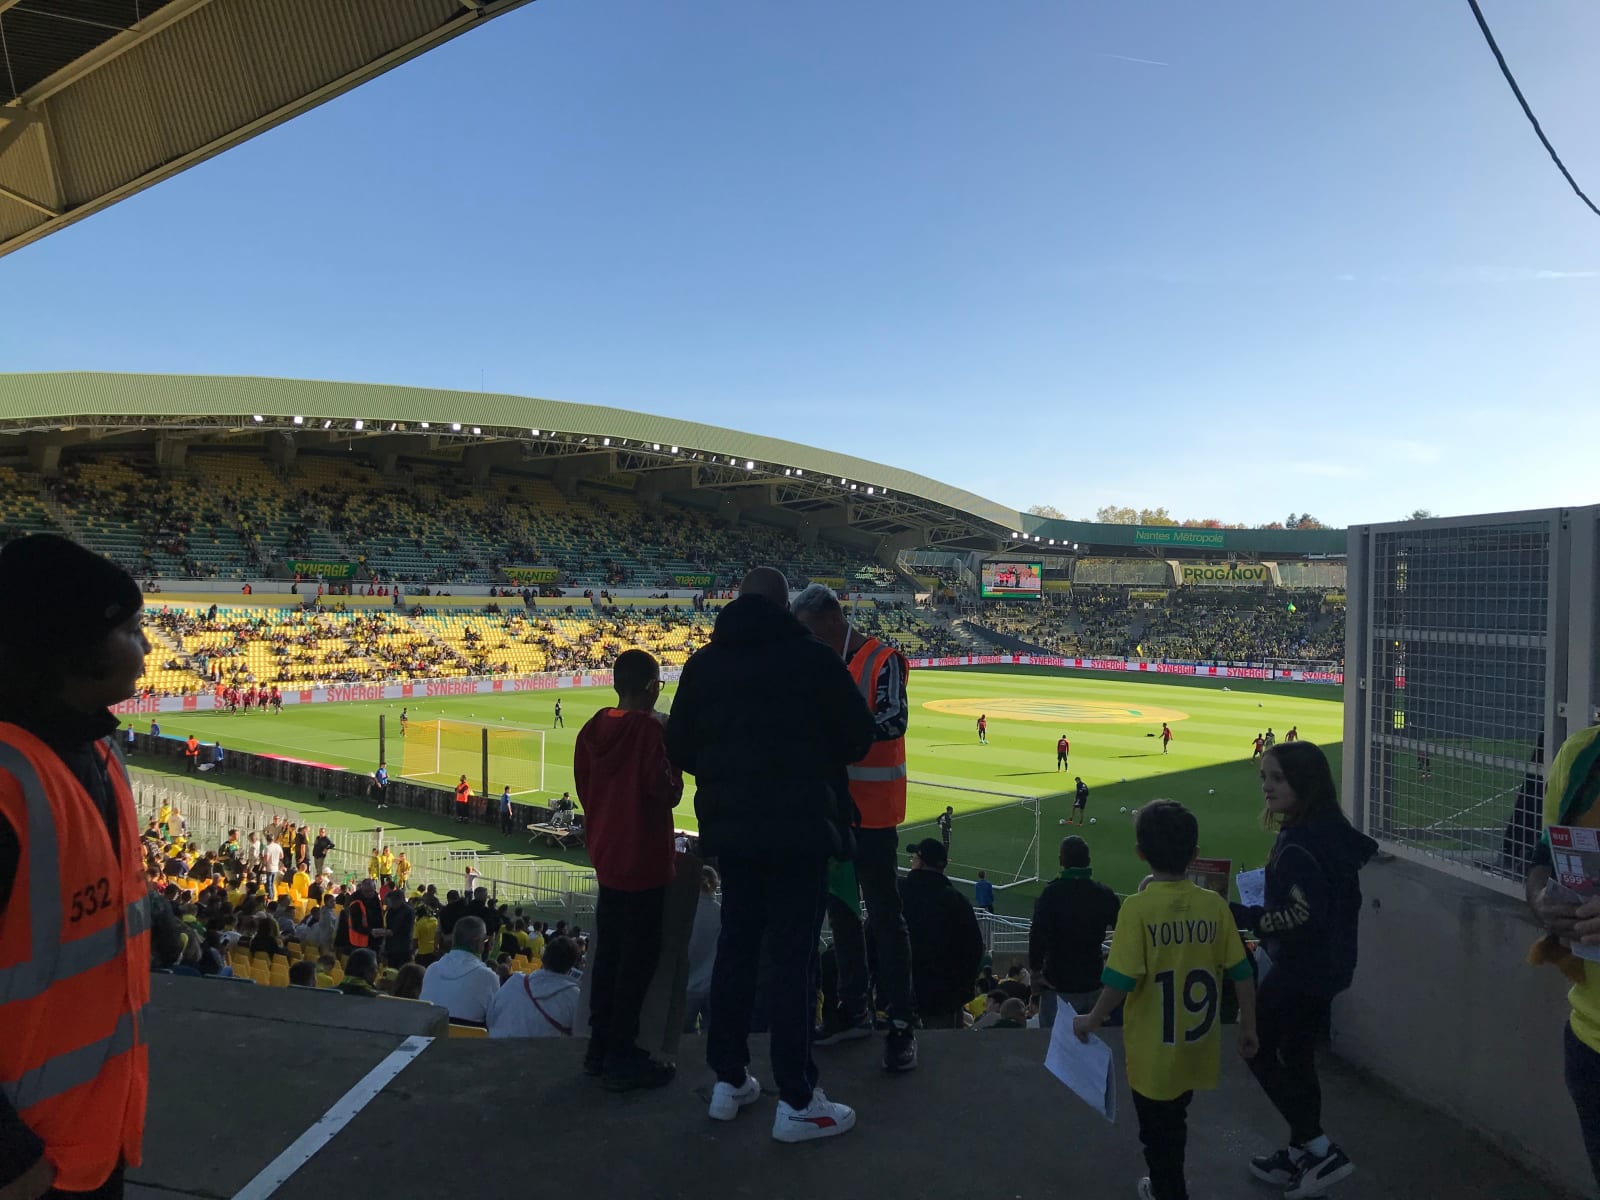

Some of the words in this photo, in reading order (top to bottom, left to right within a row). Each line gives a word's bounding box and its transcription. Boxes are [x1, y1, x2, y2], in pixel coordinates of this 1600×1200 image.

[1136, 530, 1170, 540] Nantes
[516, 571, 557, 582] NANTES
[1226, 668, 1269, 678] SYNERGIE
[426, 681, 478, 696] SYNERGIE
[514, 678, 559, 691] SYNERGIE
[327, 686, 385, 702] SYNERGIE
[70, 877, 112, 923] 532
[1147, 919, 1217, 948] YOUYOU
[1154, 968, 1219, 1045] 19
